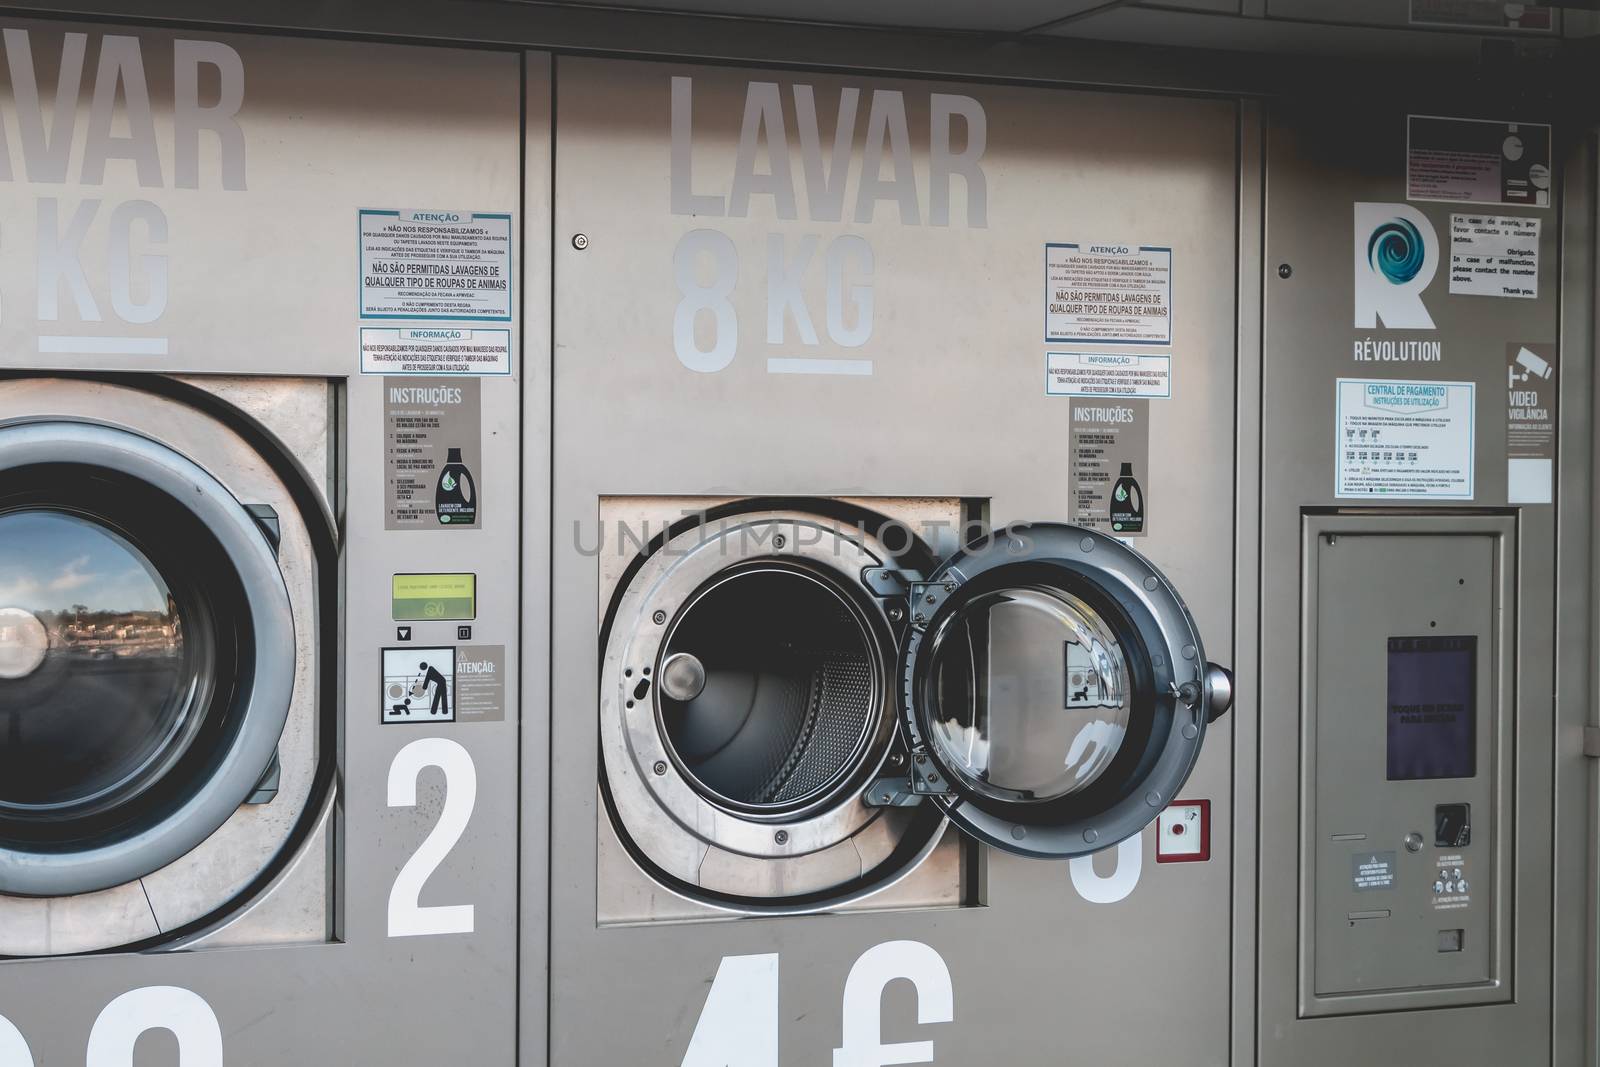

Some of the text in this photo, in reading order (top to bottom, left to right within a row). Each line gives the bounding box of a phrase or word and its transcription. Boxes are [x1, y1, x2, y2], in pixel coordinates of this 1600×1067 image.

[0, 28, 248, 191] VAR
[670, 76, 988, 229] LAVAR
[413, 213, 459, 223] ATENÇÃO
[1090, 246, 1129, 255] ATENÇÃO
[36, 197, 169, 324] KG
[372, 262, 500, 276] NÃO SÃO PERMITIDAS LAVAGENS DE
[365, 276, 507, 289] QUALQUER TIPO DE ROUPAS DE ANIMAIS
[672, 228, 875, 373] 8 KG
[1056, 291, 1161, 304] NÃO SÃO PERMITIDAS LAVAGENS DE
[1049, 304, 1168, 316] QUALQUER TIPO DE ROUPAS DE ANIMAIS
[410, 331, 461, 340] INFORMAÇÃO
[1354, 337, 1441, 362] RÉVOLUTION
[1088, 356, 1130, 365] INFORMAÇÃO
[390, 386, 462, 406] INSTRUÇÕES
[1368, 385, 1445, 396] CENTRAL DE PAGAMENTO
[1374, 396, 1403, 406] INSTRUÇÕES
[1411, 398, 1440, 406] UTILIZAÇÃO
[1074, 406, 1134, 424] INSTRUÇÕES
[1509, 407, 1548, 420] VIGILÂNCIA
[457, 660, 496, 674] ATENÇÃO:
[387, 737, 477, 937] 2
